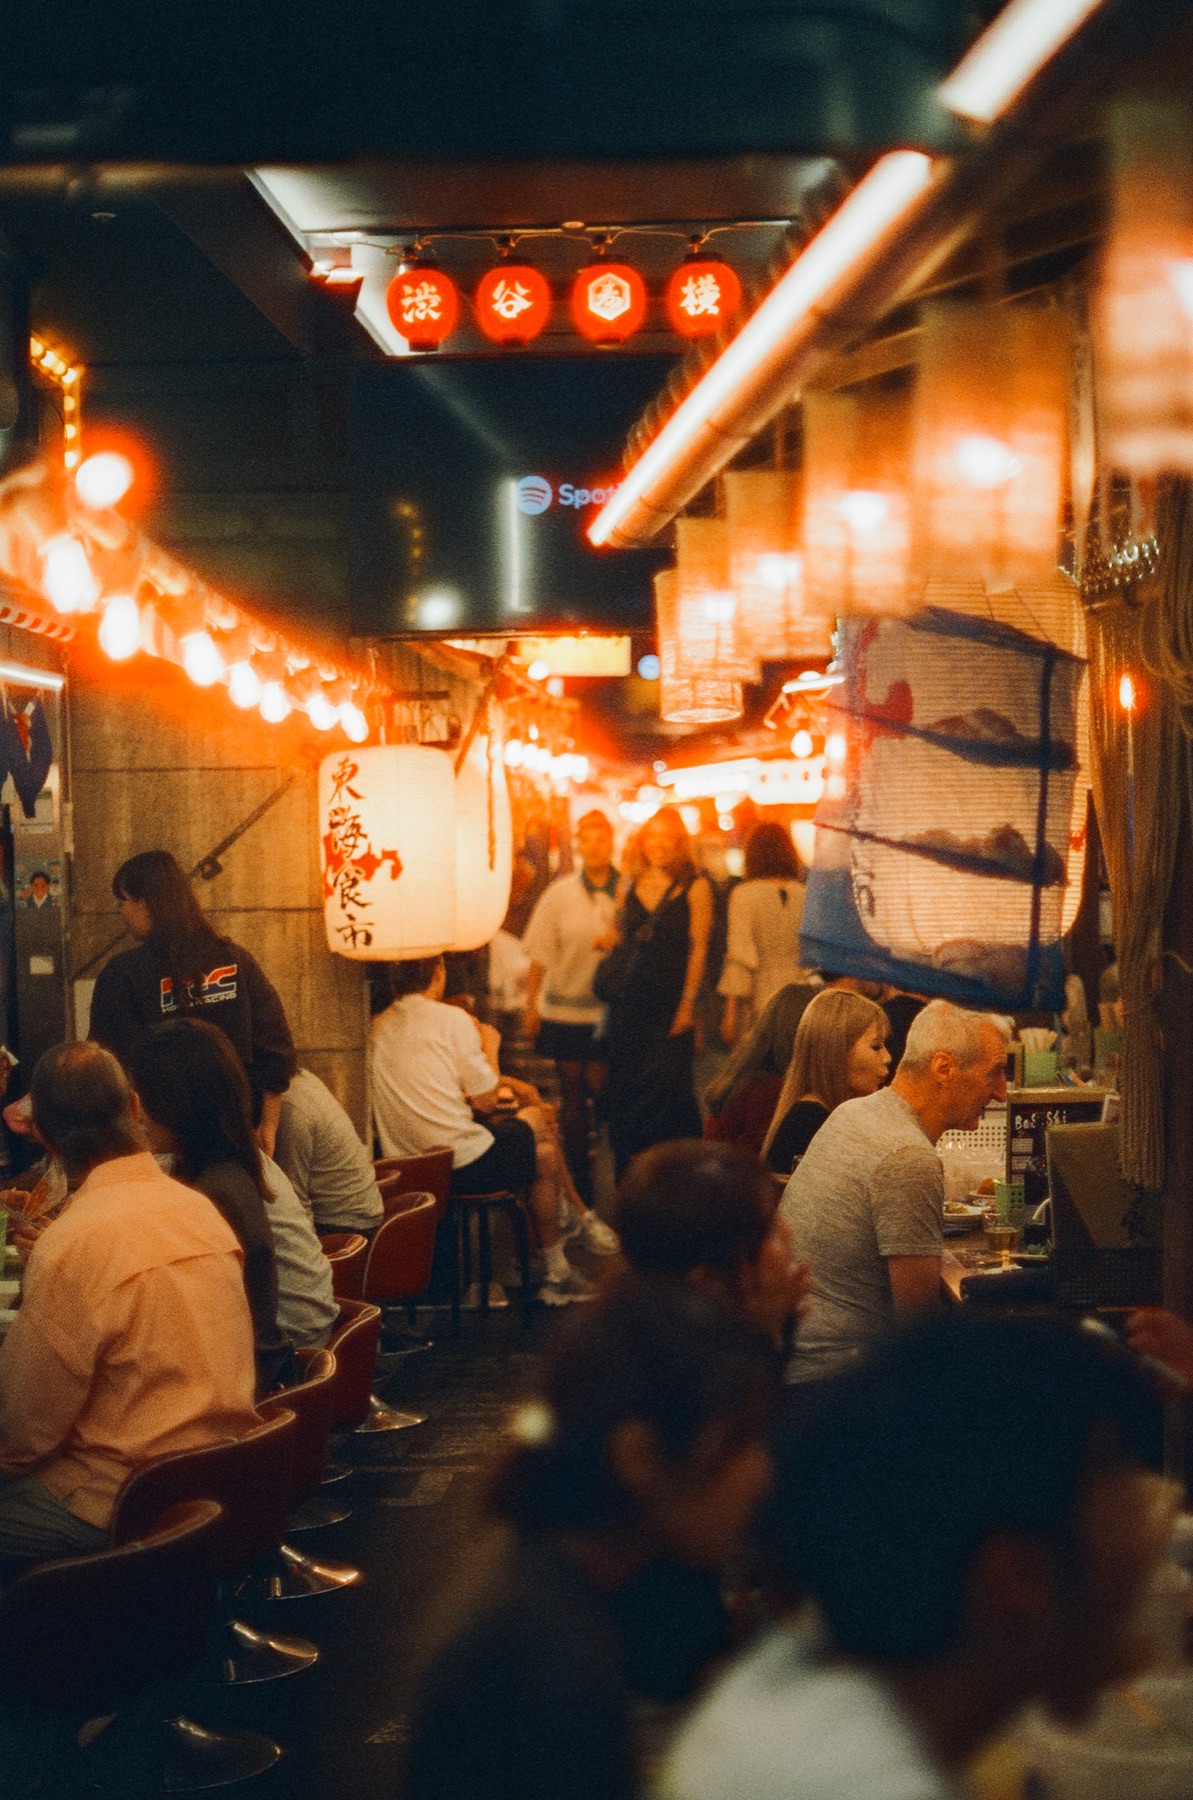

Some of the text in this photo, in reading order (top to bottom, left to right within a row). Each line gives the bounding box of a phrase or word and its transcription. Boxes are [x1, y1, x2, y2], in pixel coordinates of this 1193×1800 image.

[401, 282, 442, 323] 渋
[492, 280, 533, 319] 谷
[680, 274, 721, 316] 横
